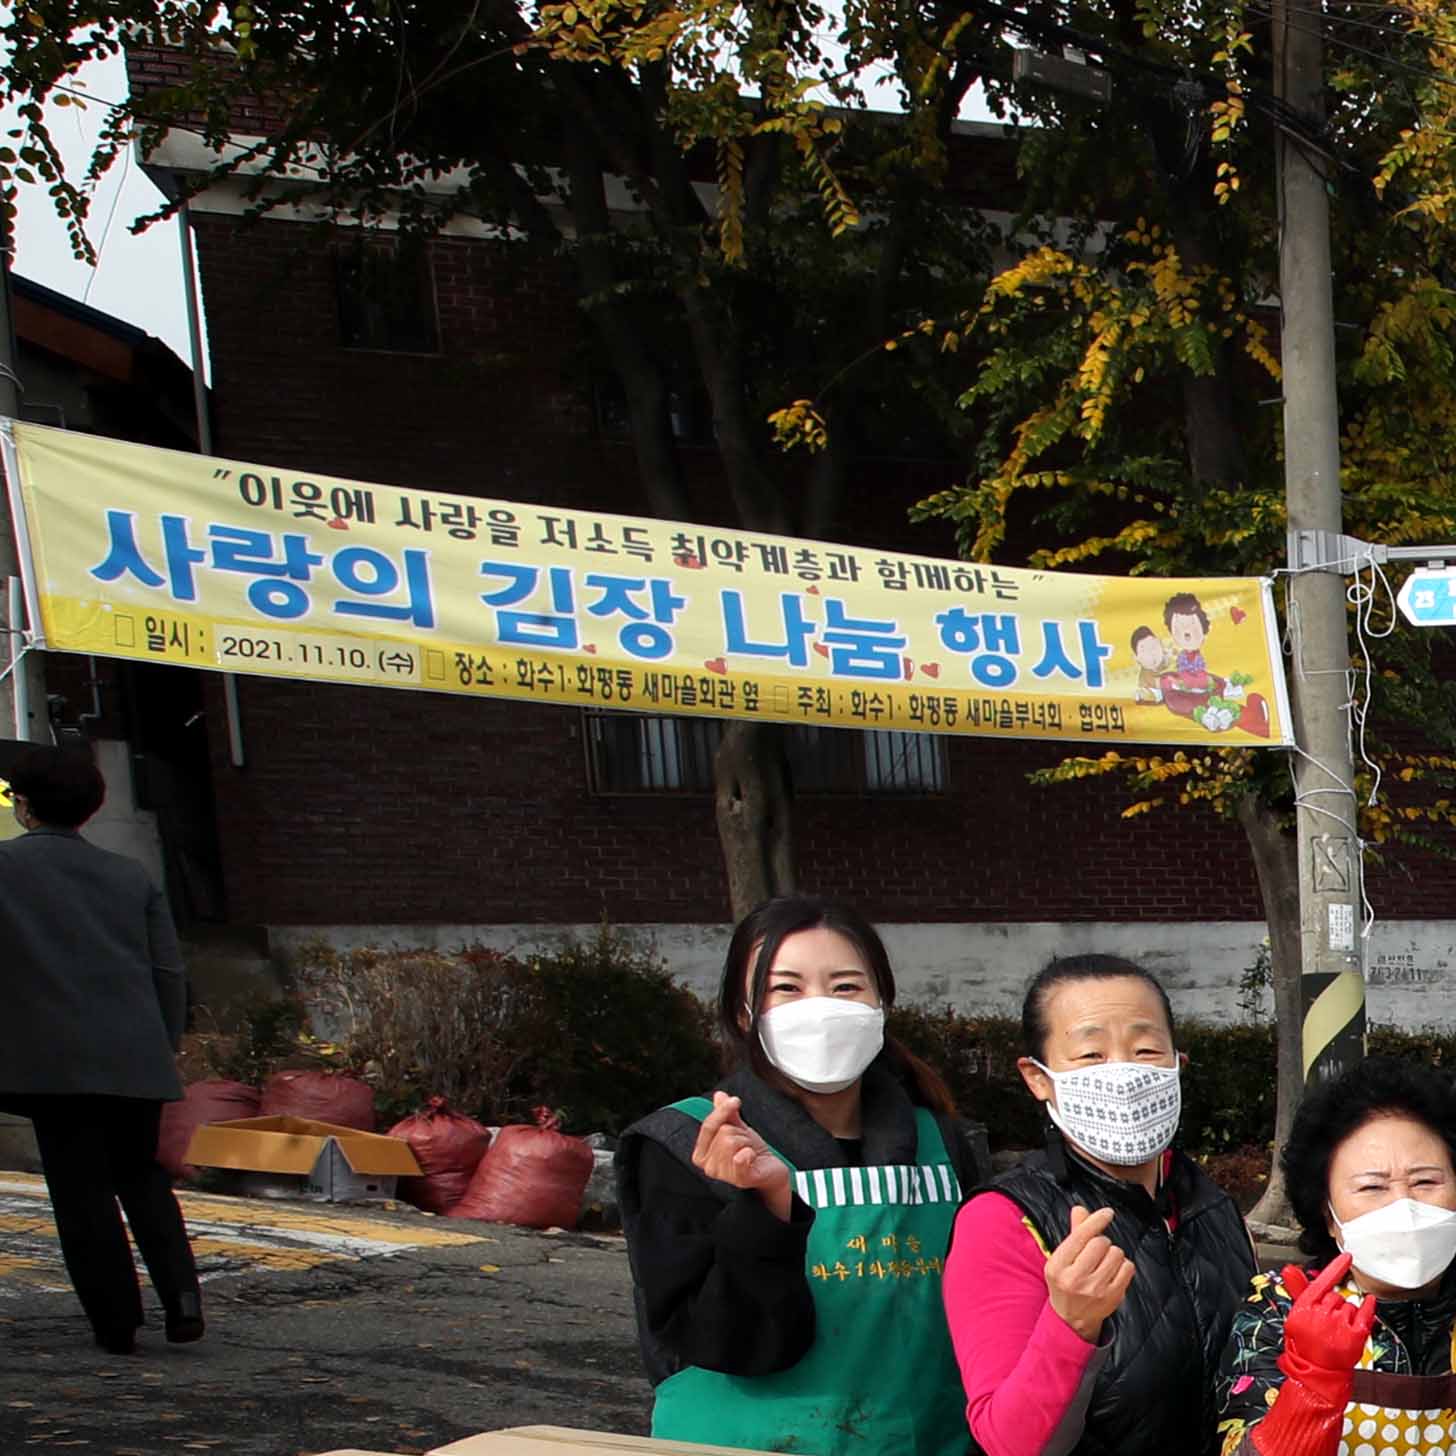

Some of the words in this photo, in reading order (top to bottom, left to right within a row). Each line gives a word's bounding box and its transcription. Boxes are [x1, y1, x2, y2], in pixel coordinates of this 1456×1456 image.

[395, 496, 520, 548] 사랑을
[537, 514, 656, 563] 저소득
[672, 533, 862, 583] 취약계층과
[90, 509, 436, 628] 사랑의
[480, 560, 686, 661] 김장
[720, 589, 907, 681] 나눔
[937, 607, 1112, 688] 행사
[145, 616, 190, 656] 일시
[455, 652, 497, 687] 장소
[641, 663, 738, 708] 새마을회관
[744, 680, 760, 708] 옆
[797, 687, 832, 720] 주최
[966, 702, 1062, 732] 새마을부녀회
[1078, 705, 1126, 735] 협의회
